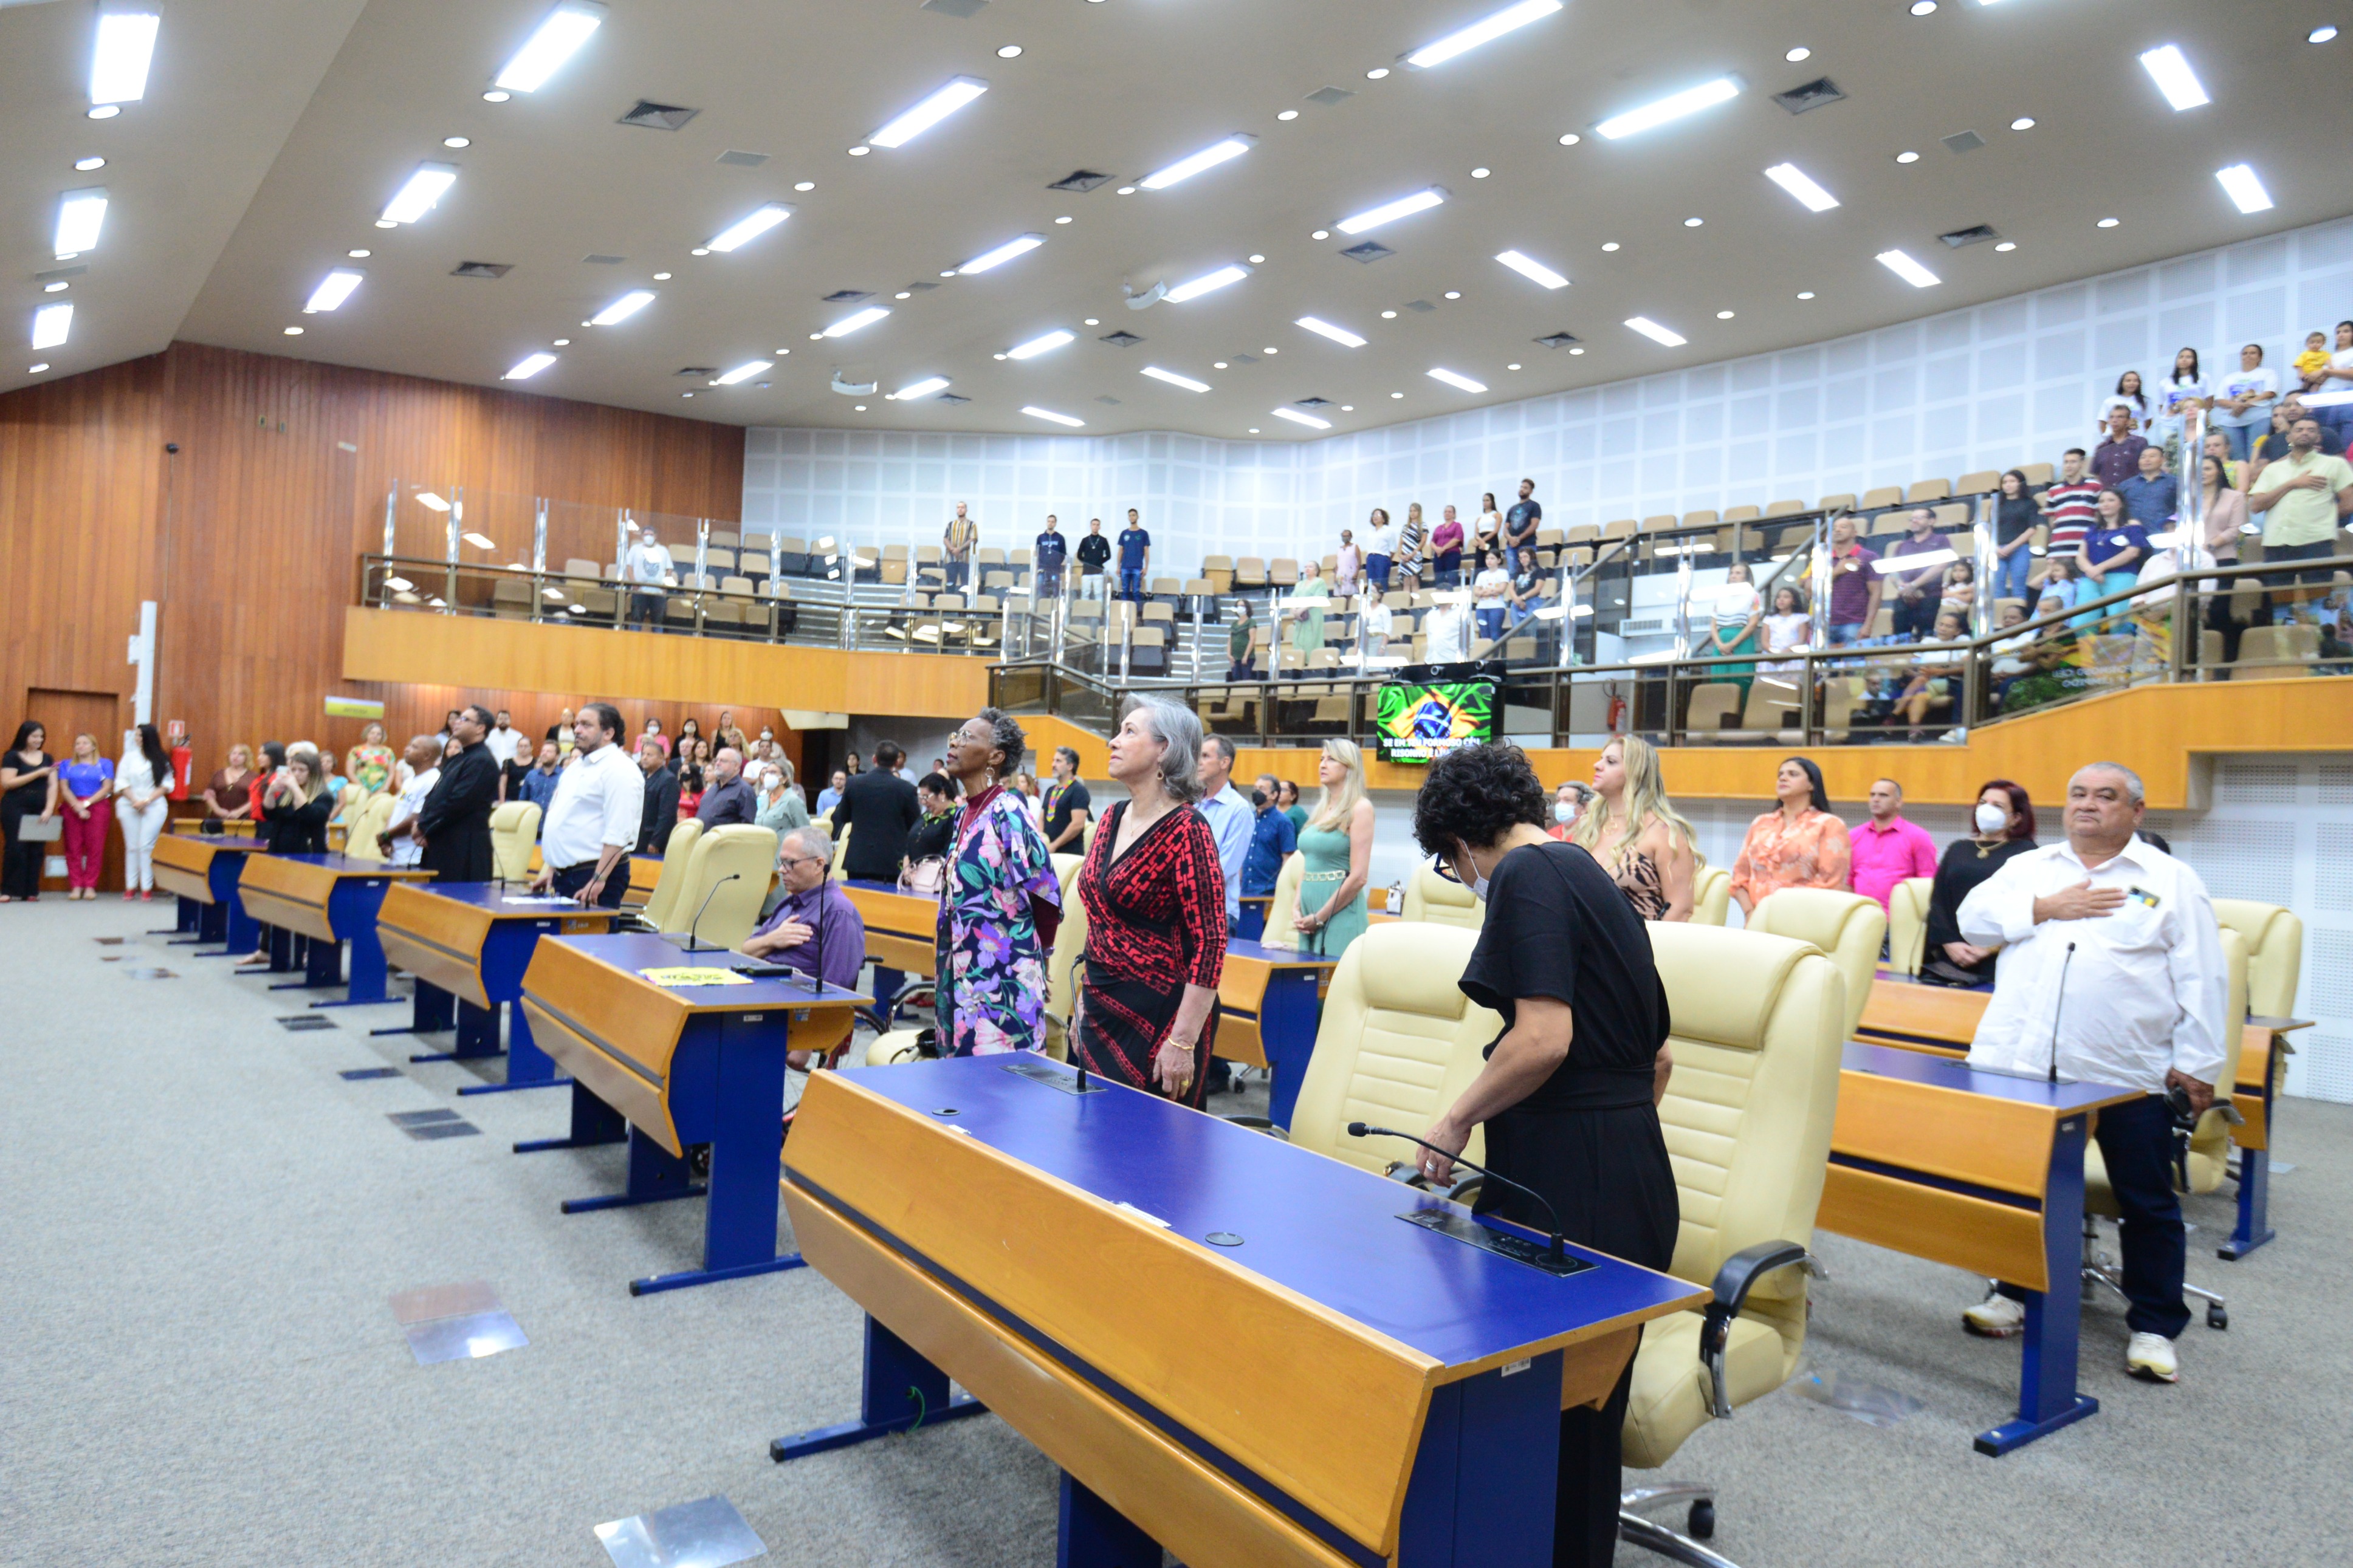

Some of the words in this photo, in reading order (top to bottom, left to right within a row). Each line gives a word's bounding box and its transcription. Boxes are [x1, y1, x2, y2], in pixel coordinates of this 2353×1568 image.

[1383, 738, 1393, 747] SE
[1394, 738, 1406, 747] EM
[1407, 738, 1422, 747] TEU
[1423, 738, 1462, 747] FORMOSO
[1391, 748, 1427, 757] RISONHO
[1429, 748, 1434, 758] E
